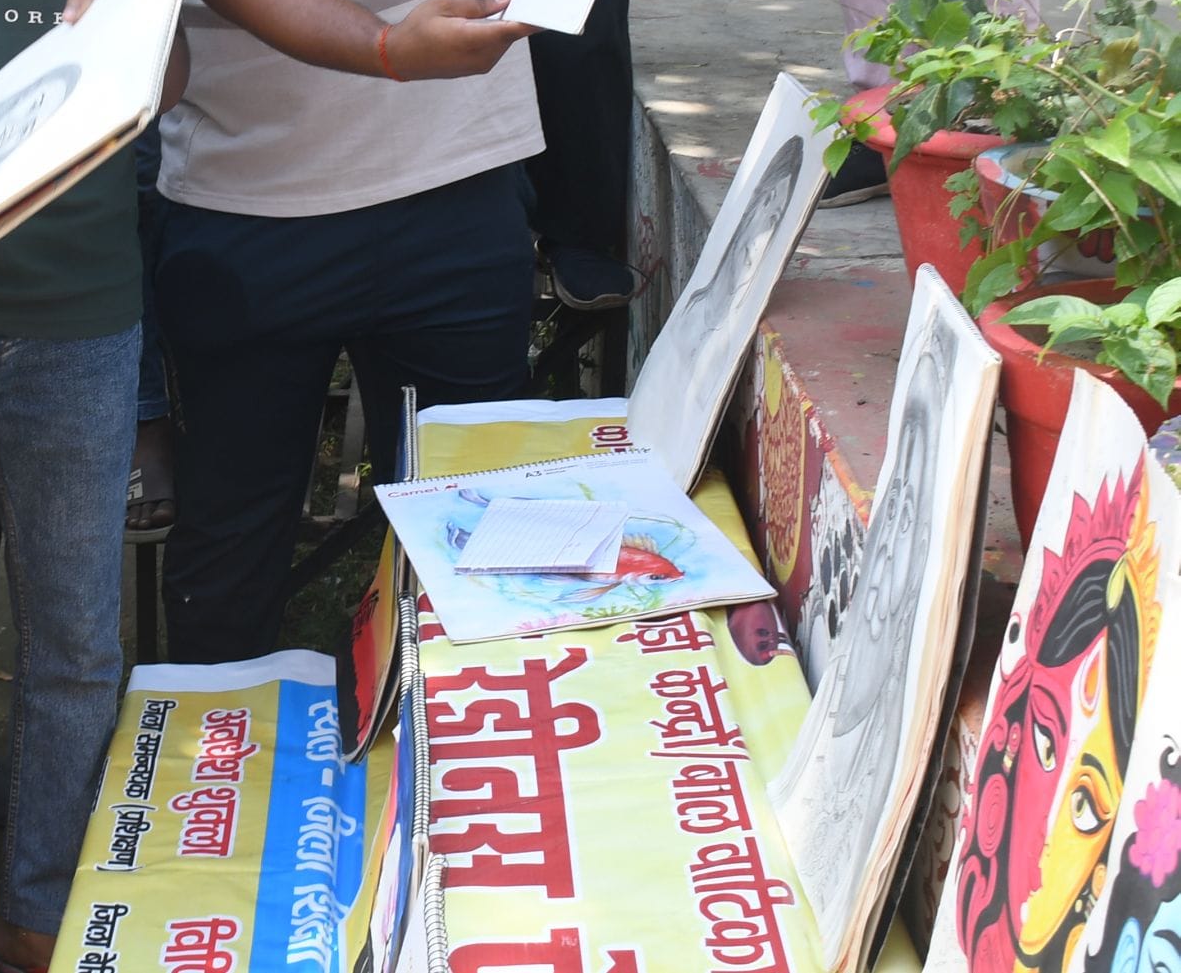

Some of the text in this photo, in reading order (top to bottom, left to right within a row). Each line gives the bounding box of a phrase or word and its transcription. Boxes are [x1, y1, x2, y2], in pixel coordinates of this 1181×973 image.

[387, 487, 440, 498] Camel
[141, 700, 176, 732] जिला
[195, 709, 257, 782] अवधेश
[125, 732, 160, 800] समन्वयक
[97, 804, 156, 871] (प्रशिक्षण)
[171, 788, 235, 856] शुक्ला
[296, 797, 356, 872] जिला
[85, 904, 128, 948] जिला
